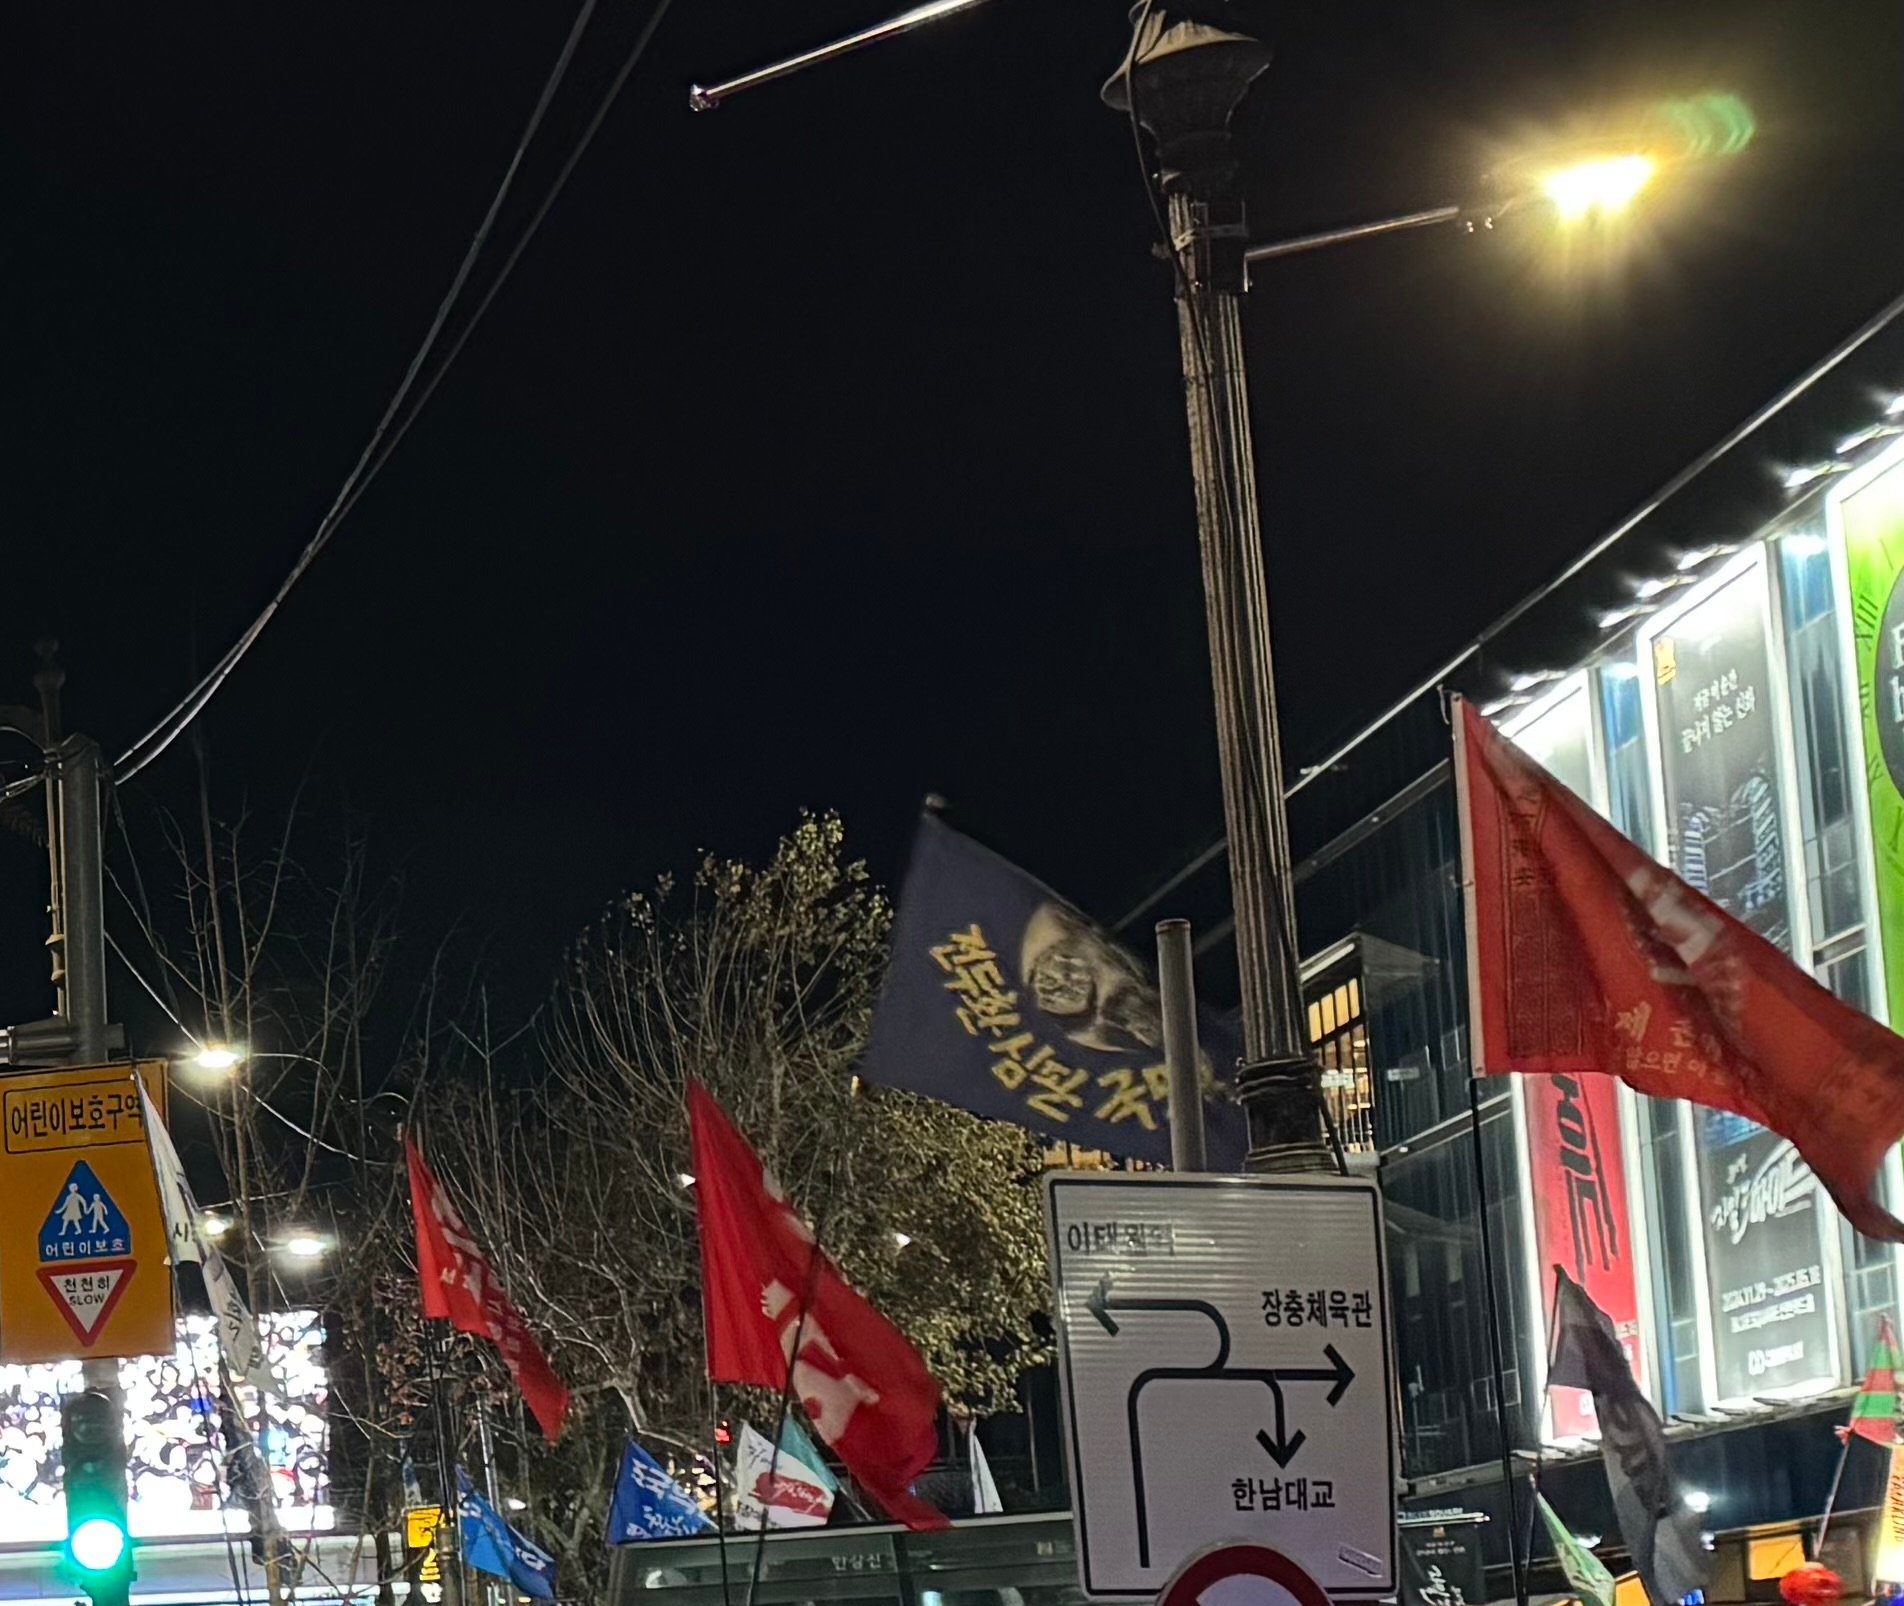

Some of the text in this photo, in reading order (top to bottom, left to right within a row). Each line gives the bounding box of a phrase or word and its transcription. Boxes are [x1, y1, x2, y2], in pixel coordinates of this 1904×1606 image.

[929, 923, 1022, 1037] 전두환
[989, 1031, 1089, 1123] 심판
[11, 1094, 142, 1138] 어린이보호구역
[45, 1237, 126, 1257] 어린이보호
[63, 1274, 110, 1294] 천천히
[68, 1293, 106, 1307] SLOW
[1261, 1289, 1373, 1328] 장충체육관
[1231, 1477, 1336, 1512] 한남대교
